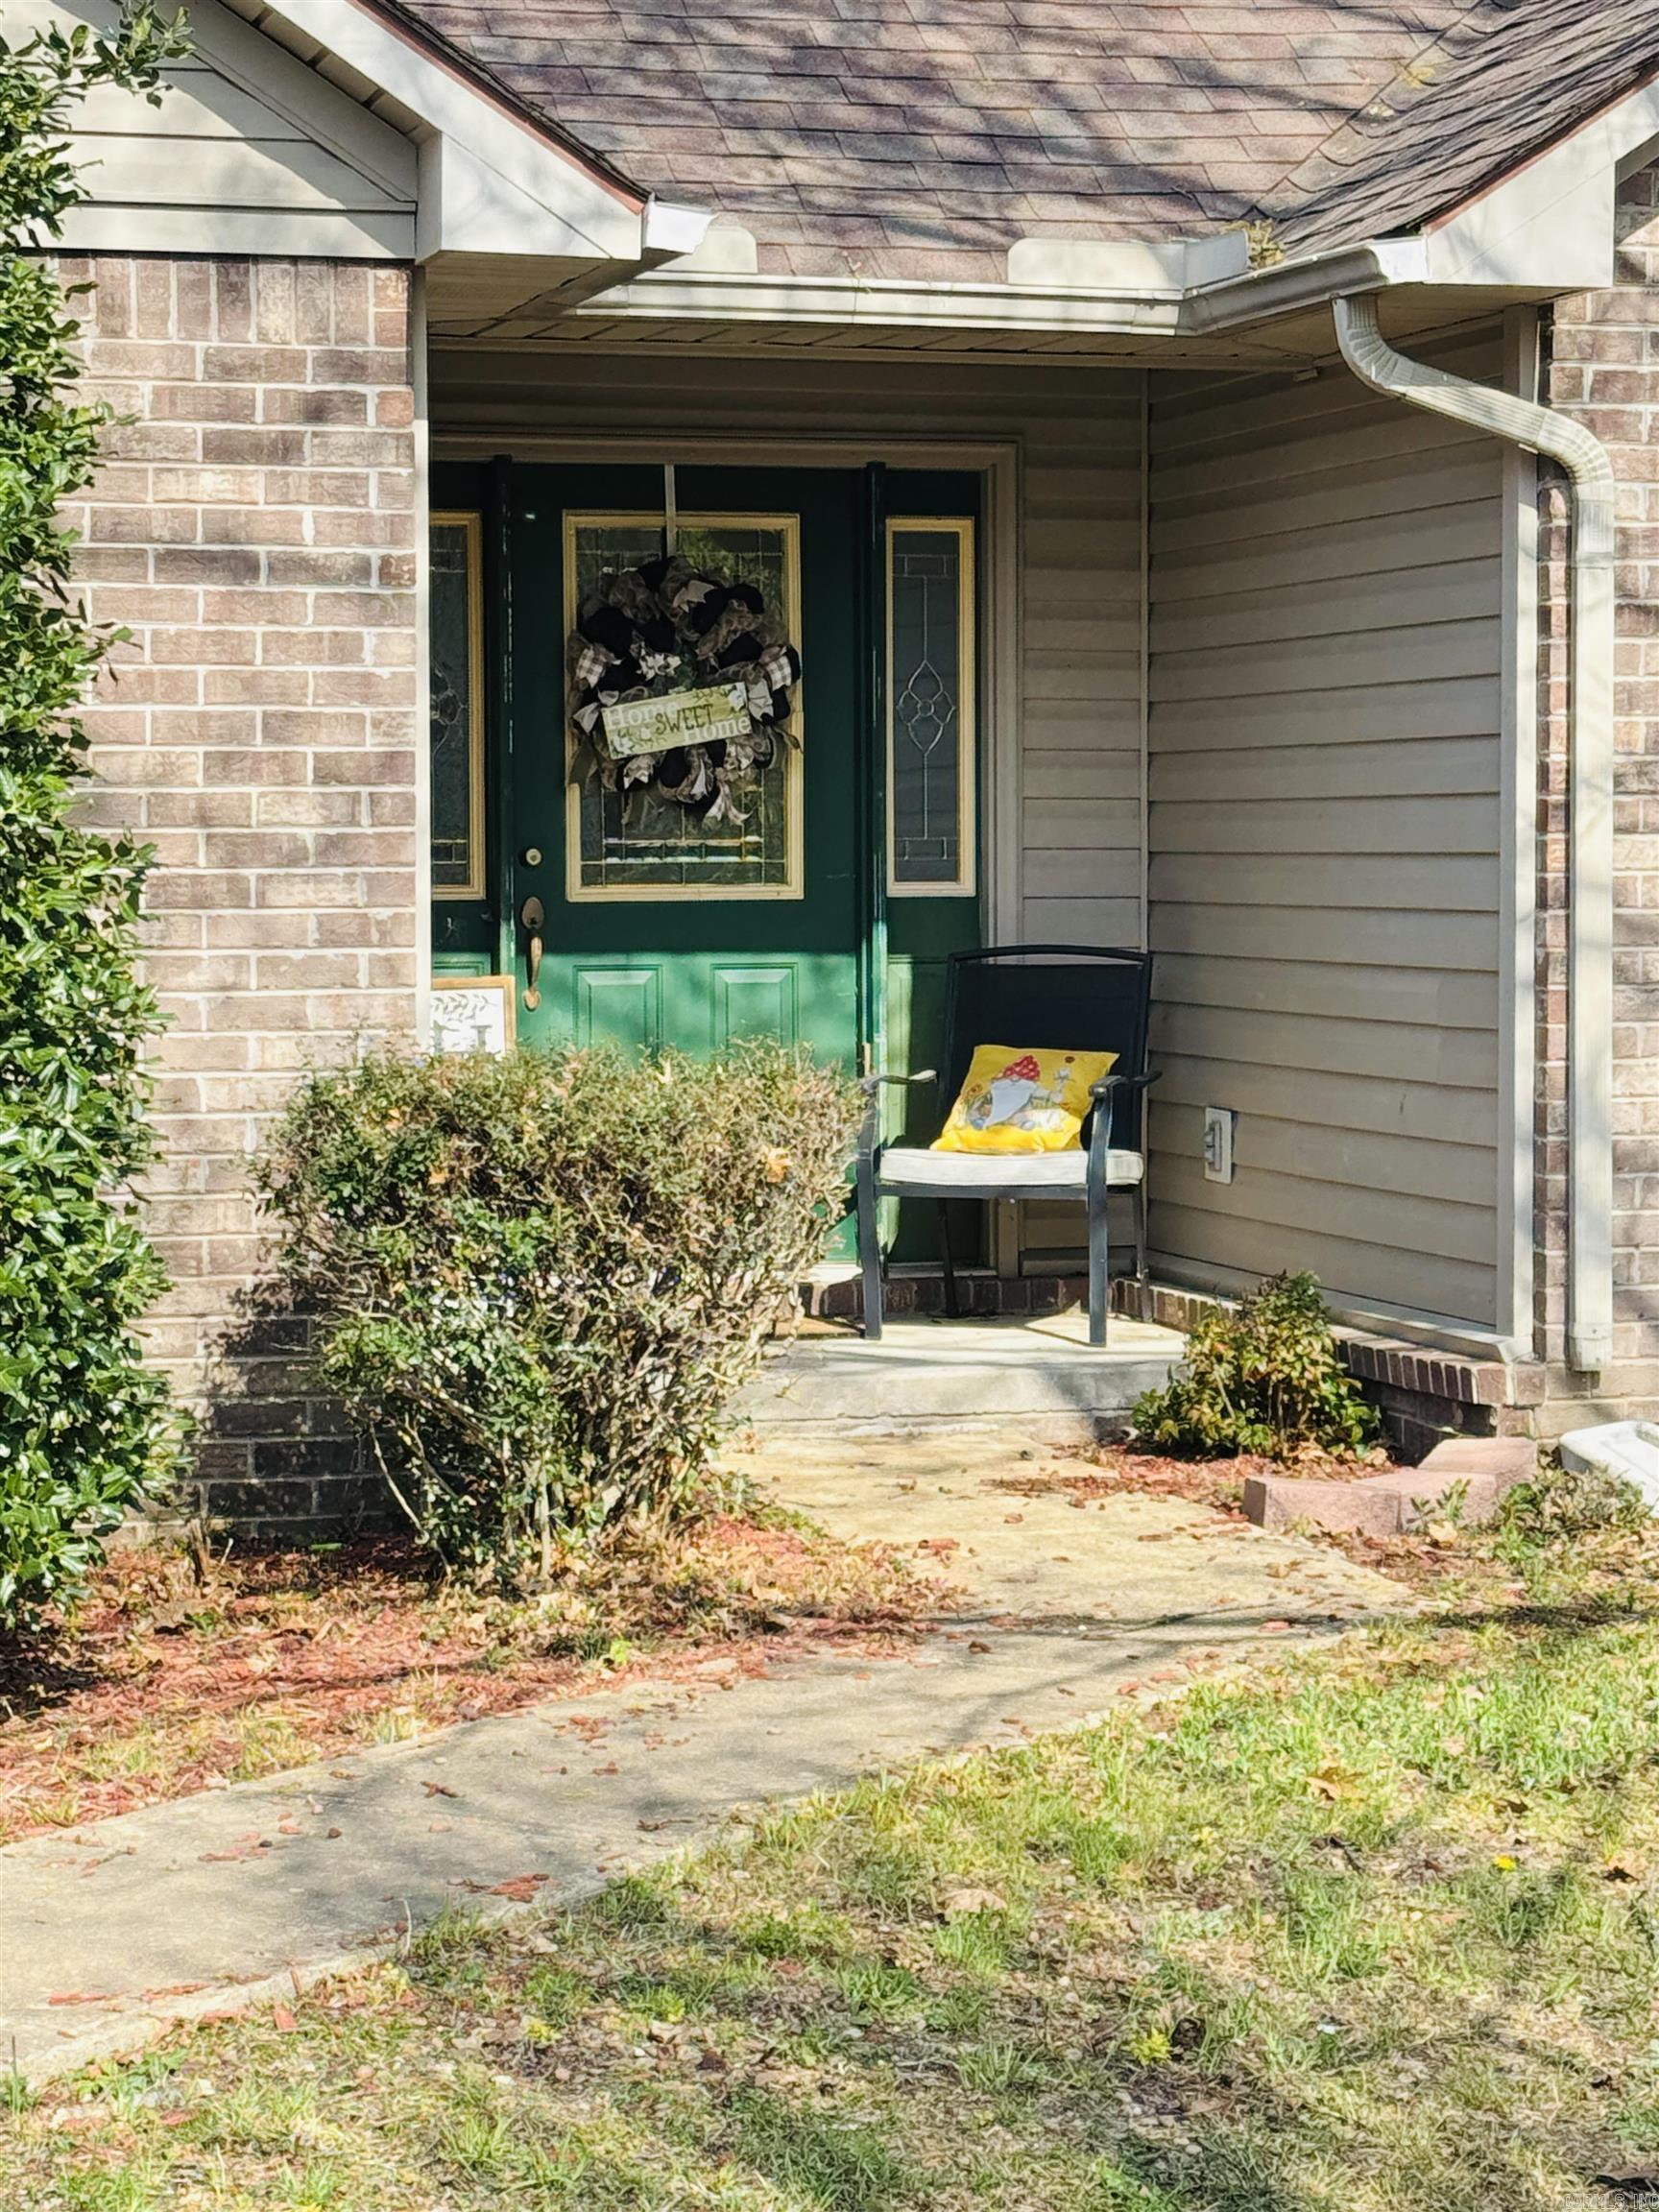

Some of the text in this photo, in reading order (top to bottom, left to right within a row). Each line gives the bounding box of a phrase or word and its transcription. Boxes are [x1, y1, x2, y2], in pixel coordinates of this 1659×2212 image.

[606, 703, 680, 730] Home
[654, 703, 714, 735] SWEET
[683, 717, 751, 743] Home
